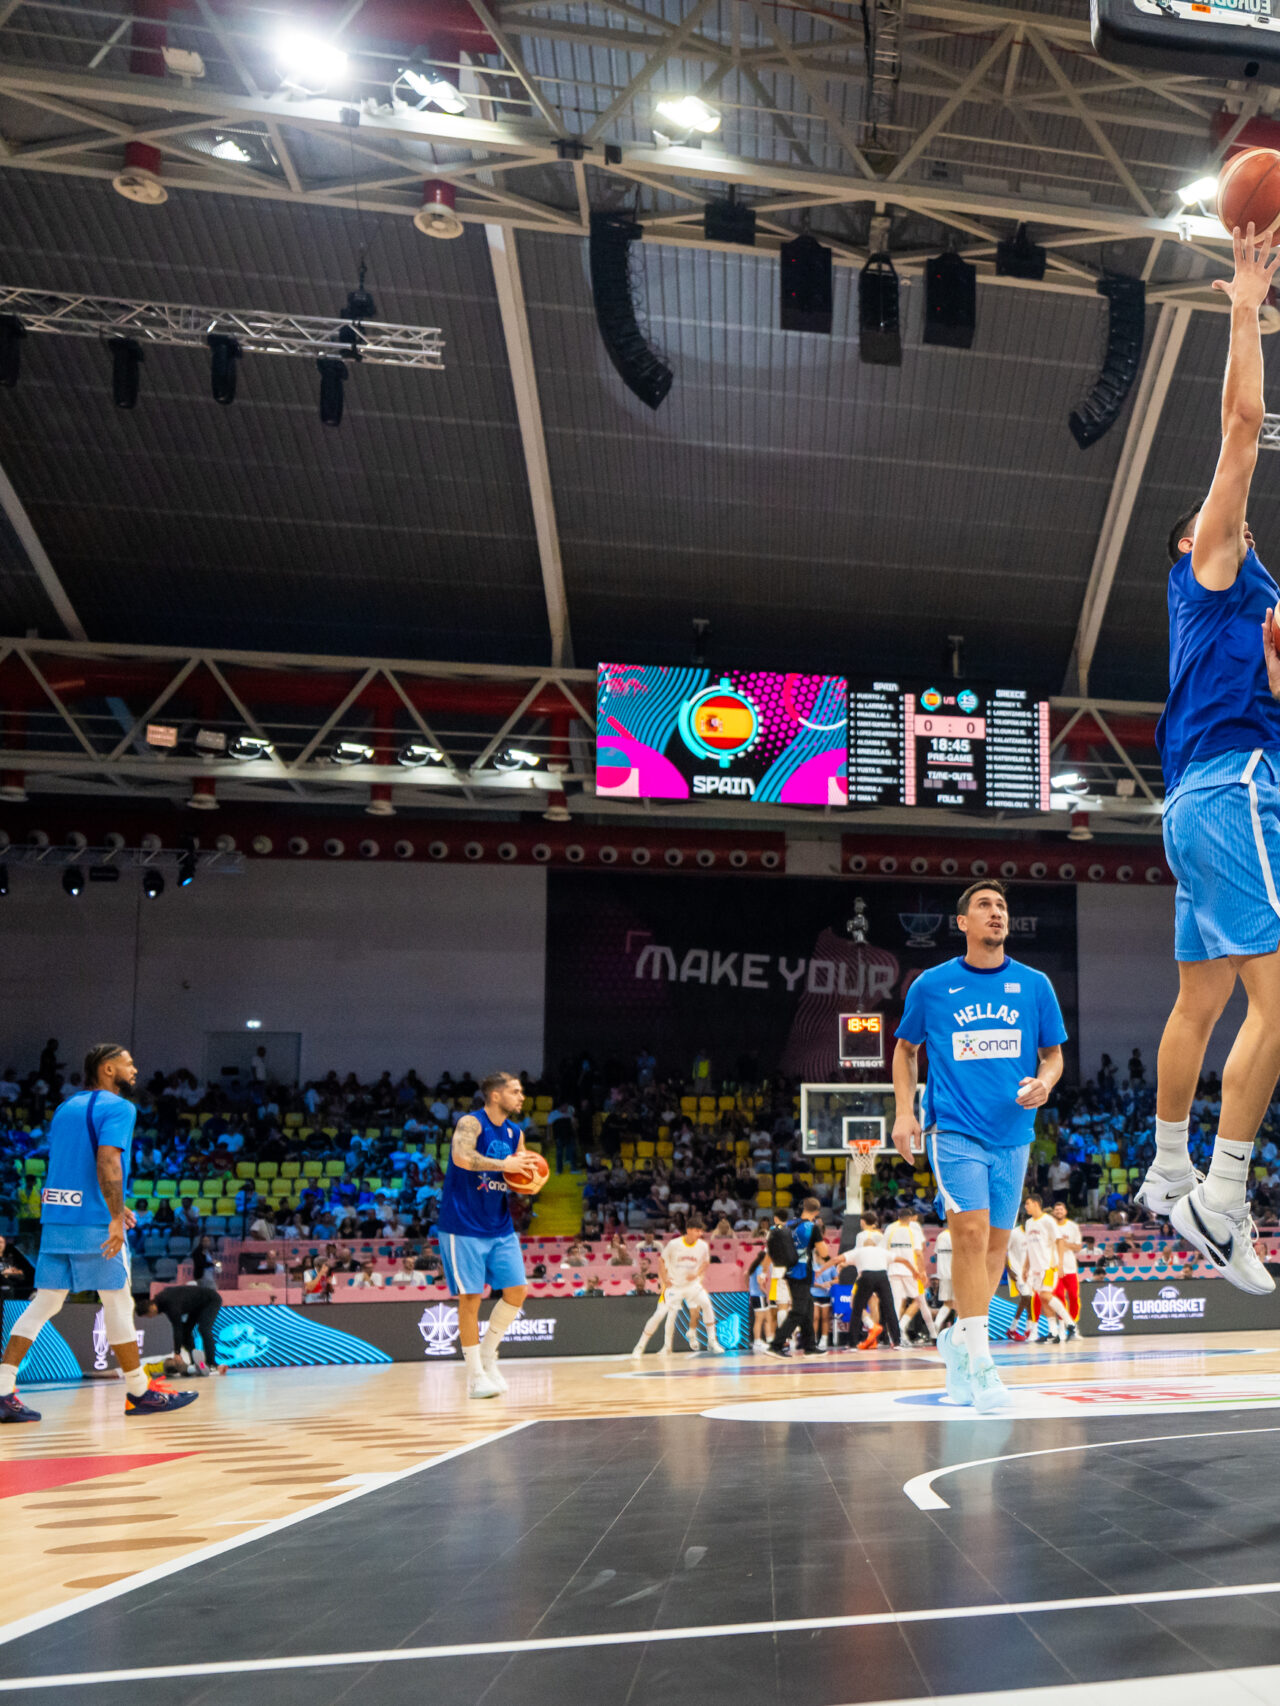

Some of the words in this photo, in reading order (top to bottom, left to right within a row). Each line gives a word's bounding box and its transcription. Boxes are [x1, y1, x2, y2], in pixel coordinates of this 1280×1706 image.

[924, 720, 933, 732] 0
[966, 722, 975, 734] 0
[931, 738, 971, 752] 18:45
[927, 753, 974, 763] PRE-GAME
[927, 771, 974, 781] TIME-OUTS
[693, 775, 756, 795] SPAIN
[937, 794, 964, 804] FOULS
[635, 944, 770, 989] MAKE
[778, 956, 895, 999] YOUR
[953, 1002, 1019, 1027] HELLAS
[847, 1017, 880, 1033] 18:45
[851, 1060, 884, 1068] TISSOT
[46, 1190, 82, 1205] EKO
[1132, 1298, 1206, 1313] EUROBASKET
